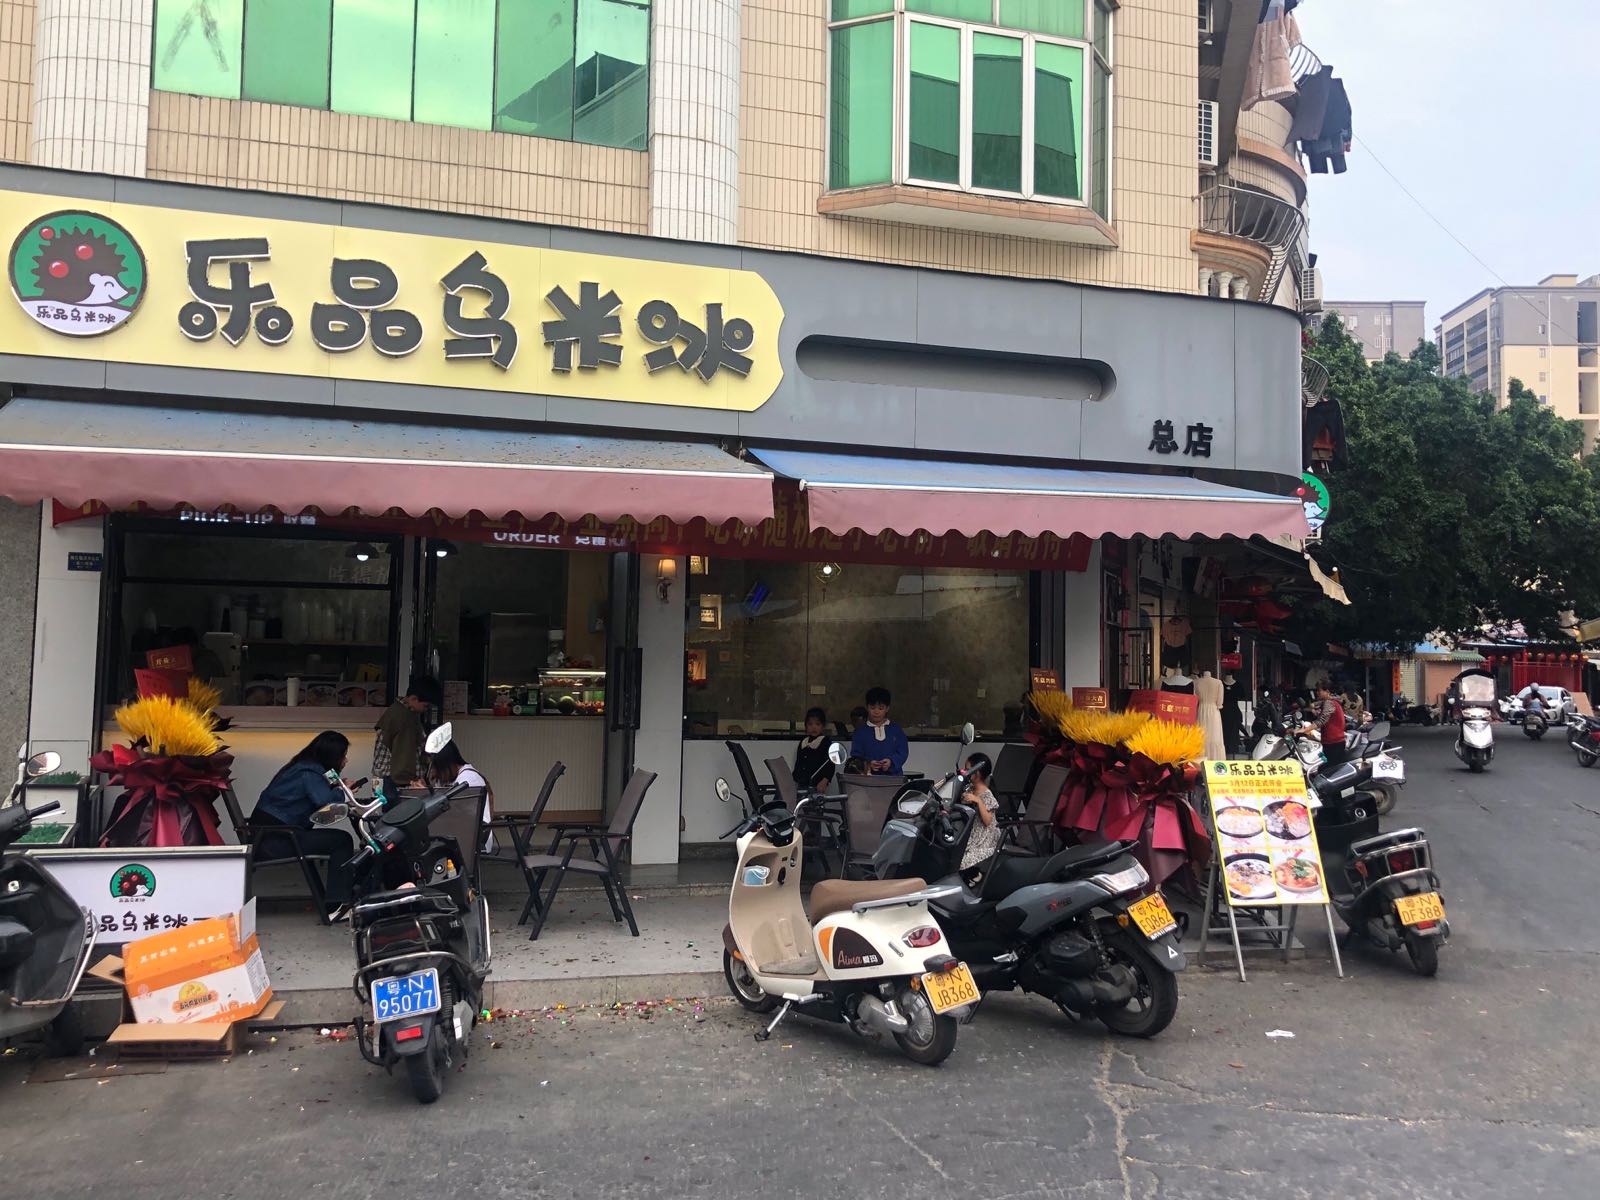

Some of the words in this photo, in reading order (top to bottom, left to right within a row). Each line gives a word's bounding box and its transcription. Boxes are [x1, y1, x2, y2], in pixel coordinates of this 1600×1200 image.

[36, 305, 116, 324] 乐品乌米冰
[177, 237, 755, 384] 乐品乌米冰
[1148, 419, 1214, 458] 总店
[1229, 763, 1294, 777] 乐品乌米冰
[1402, 905, 1442, 923] DF388
[380, 990, 433, 1017] 95077
[937, 982, 975, 1008] JB368
